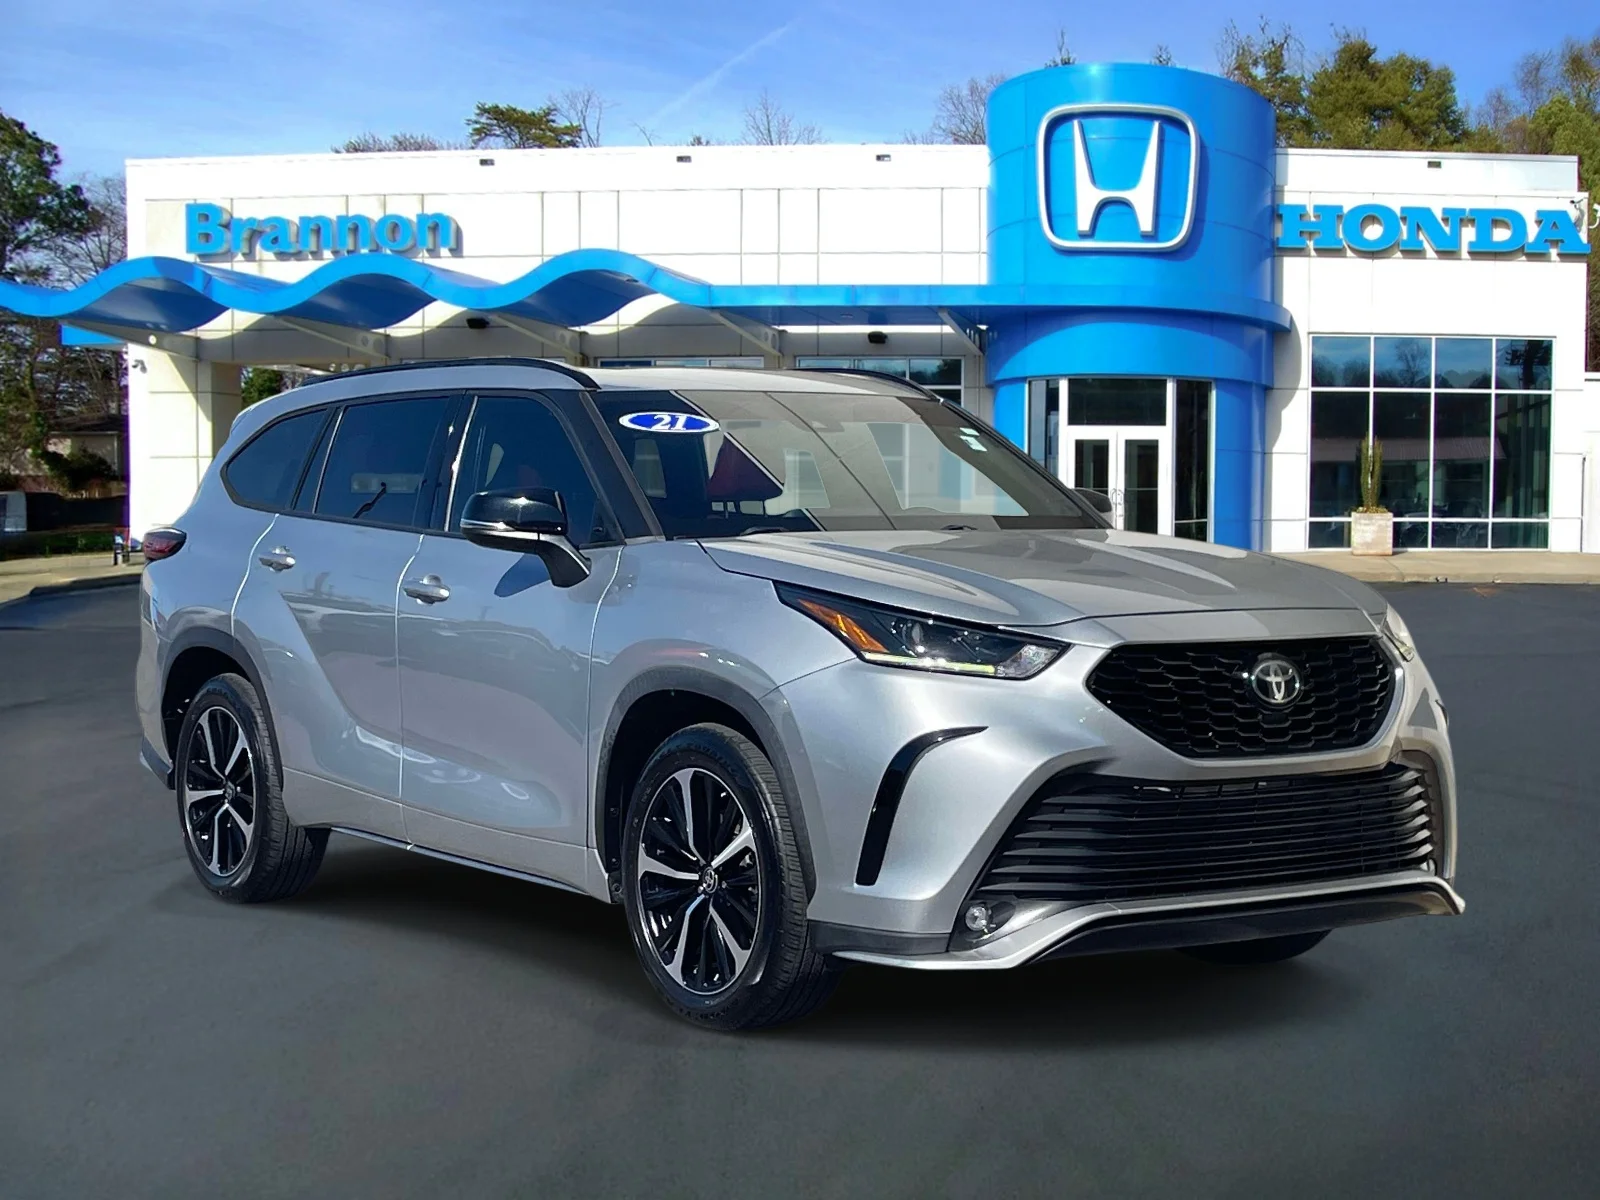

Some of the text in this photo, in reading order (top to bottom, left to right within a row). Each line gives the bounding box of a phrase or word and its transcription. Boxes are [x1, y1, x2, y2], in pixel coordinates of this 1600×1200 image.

[186, 202, 459, 258] Brannon
[1277, 204, 1591, 254] HONDA
[651, 414, 687, 430] 21
